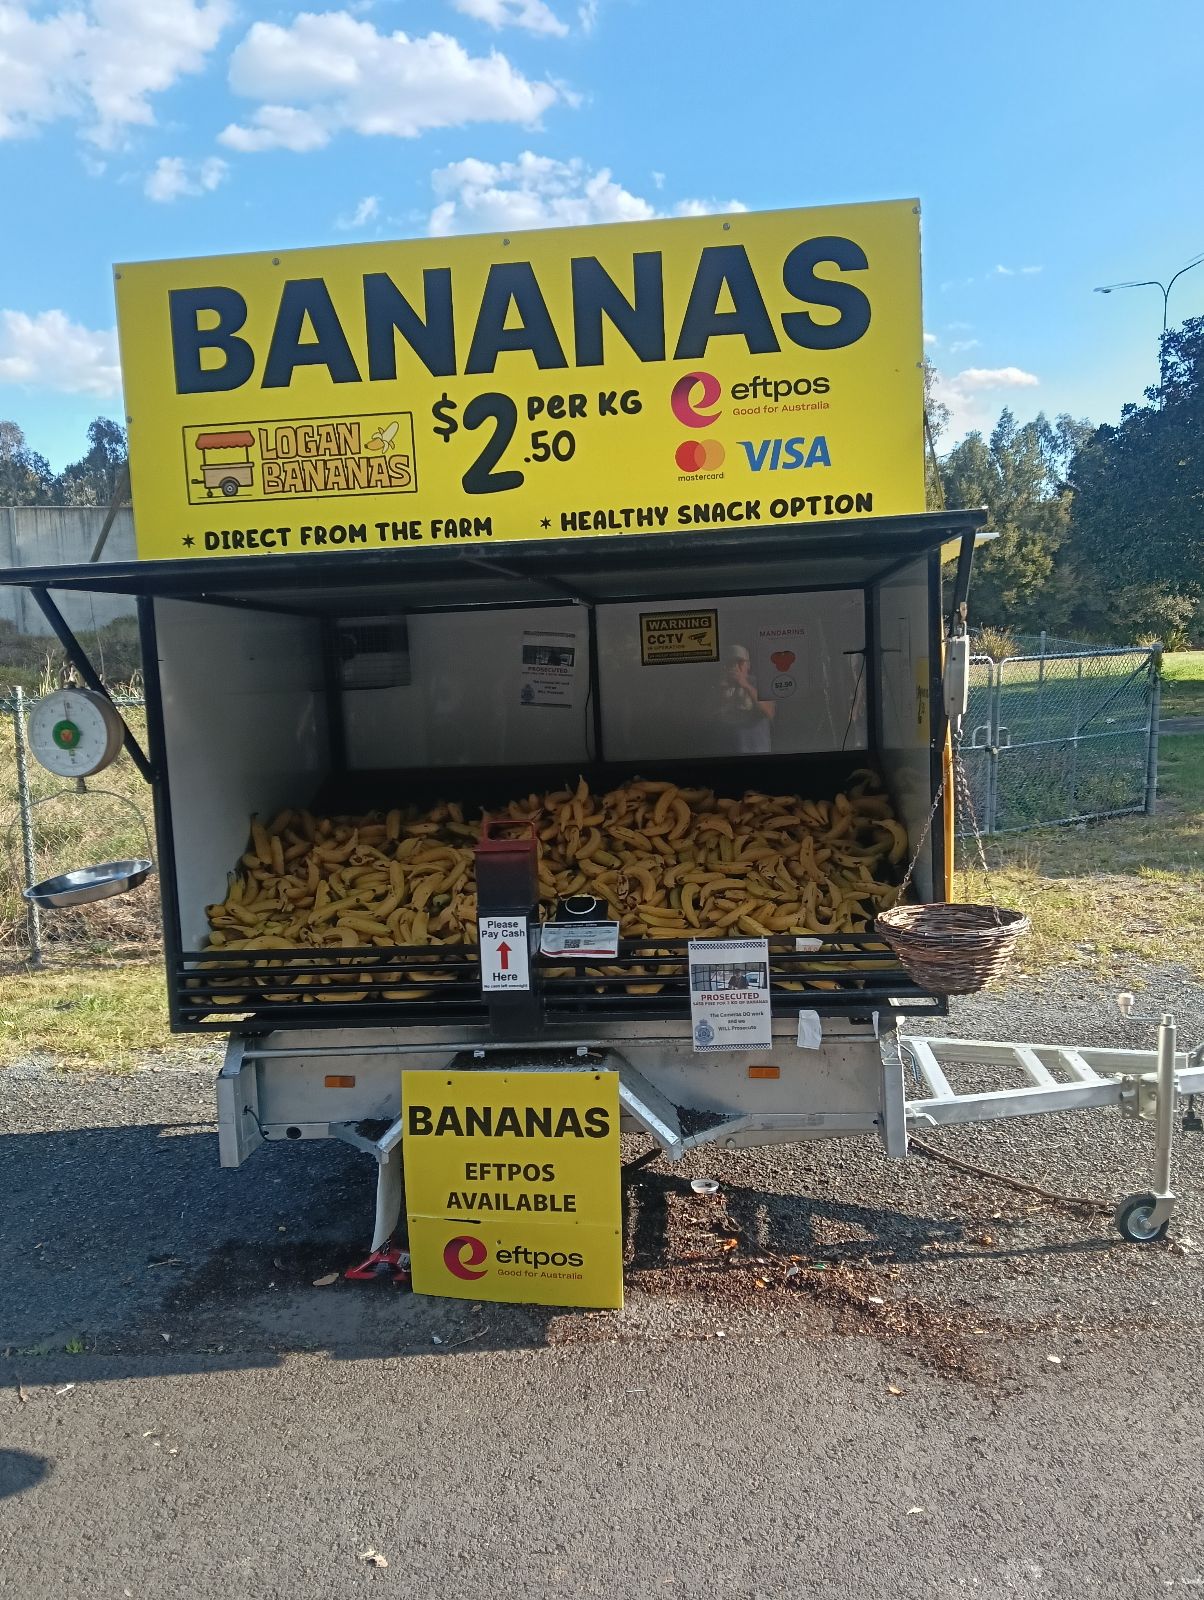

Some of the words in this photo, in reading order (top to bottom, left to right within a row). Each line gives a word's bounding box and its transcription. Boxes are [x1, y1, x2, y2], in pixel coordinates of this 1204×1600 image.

[168, 236, 871, 394] BANANAS
[731, 376, 830, 402] eftpos
[599, 389, 642, 416] KG
[733, 407, 760, 415] Good
[763, 405, 778, 413] for
[782, 401, 830, 412] Australia
[258, 422, 361, 460] LOGAN
[736, 436, 831, 471] VISA
[262, 454, 412, 494] BANANAS
[678, 472, 724, 482] mastercard
[561, 507, 668, 531] HEALTHY
[678, 500, 760, 524] SNACK
[770, 493, 873, 518] OPTION
[205, 528, 291, 550] DIRECT
[301, 524, 367, 545] FROM
[375, 521, 422, 541] THE
[431, 517, 492, 538] FARM
[649, 618, 709, 630] WARNING
[760, 629, 805, 637] MANDARINS
[647, 632, 684, 644] CCTV
[482, 930, 498, 939] Pay
[502, 929, 525, 937] Cash
[488, 920, 519, 929] Please
[493, 972, 518, 981] Here
[701, 992, 760, 1001] PROSECUTED
[408, 1105, 610, 1138] BANANAS
[465, 1163, 555, 1182] EFTPOS
[447, 1192, 577, 1212] AVAILABLE
[496, 1246, 583, 1269] eftpos
[497, 1269, 522, 1277] Good
[525, 1270, 538, 1278] for
[541, 1271, 583, 1280] Australia
